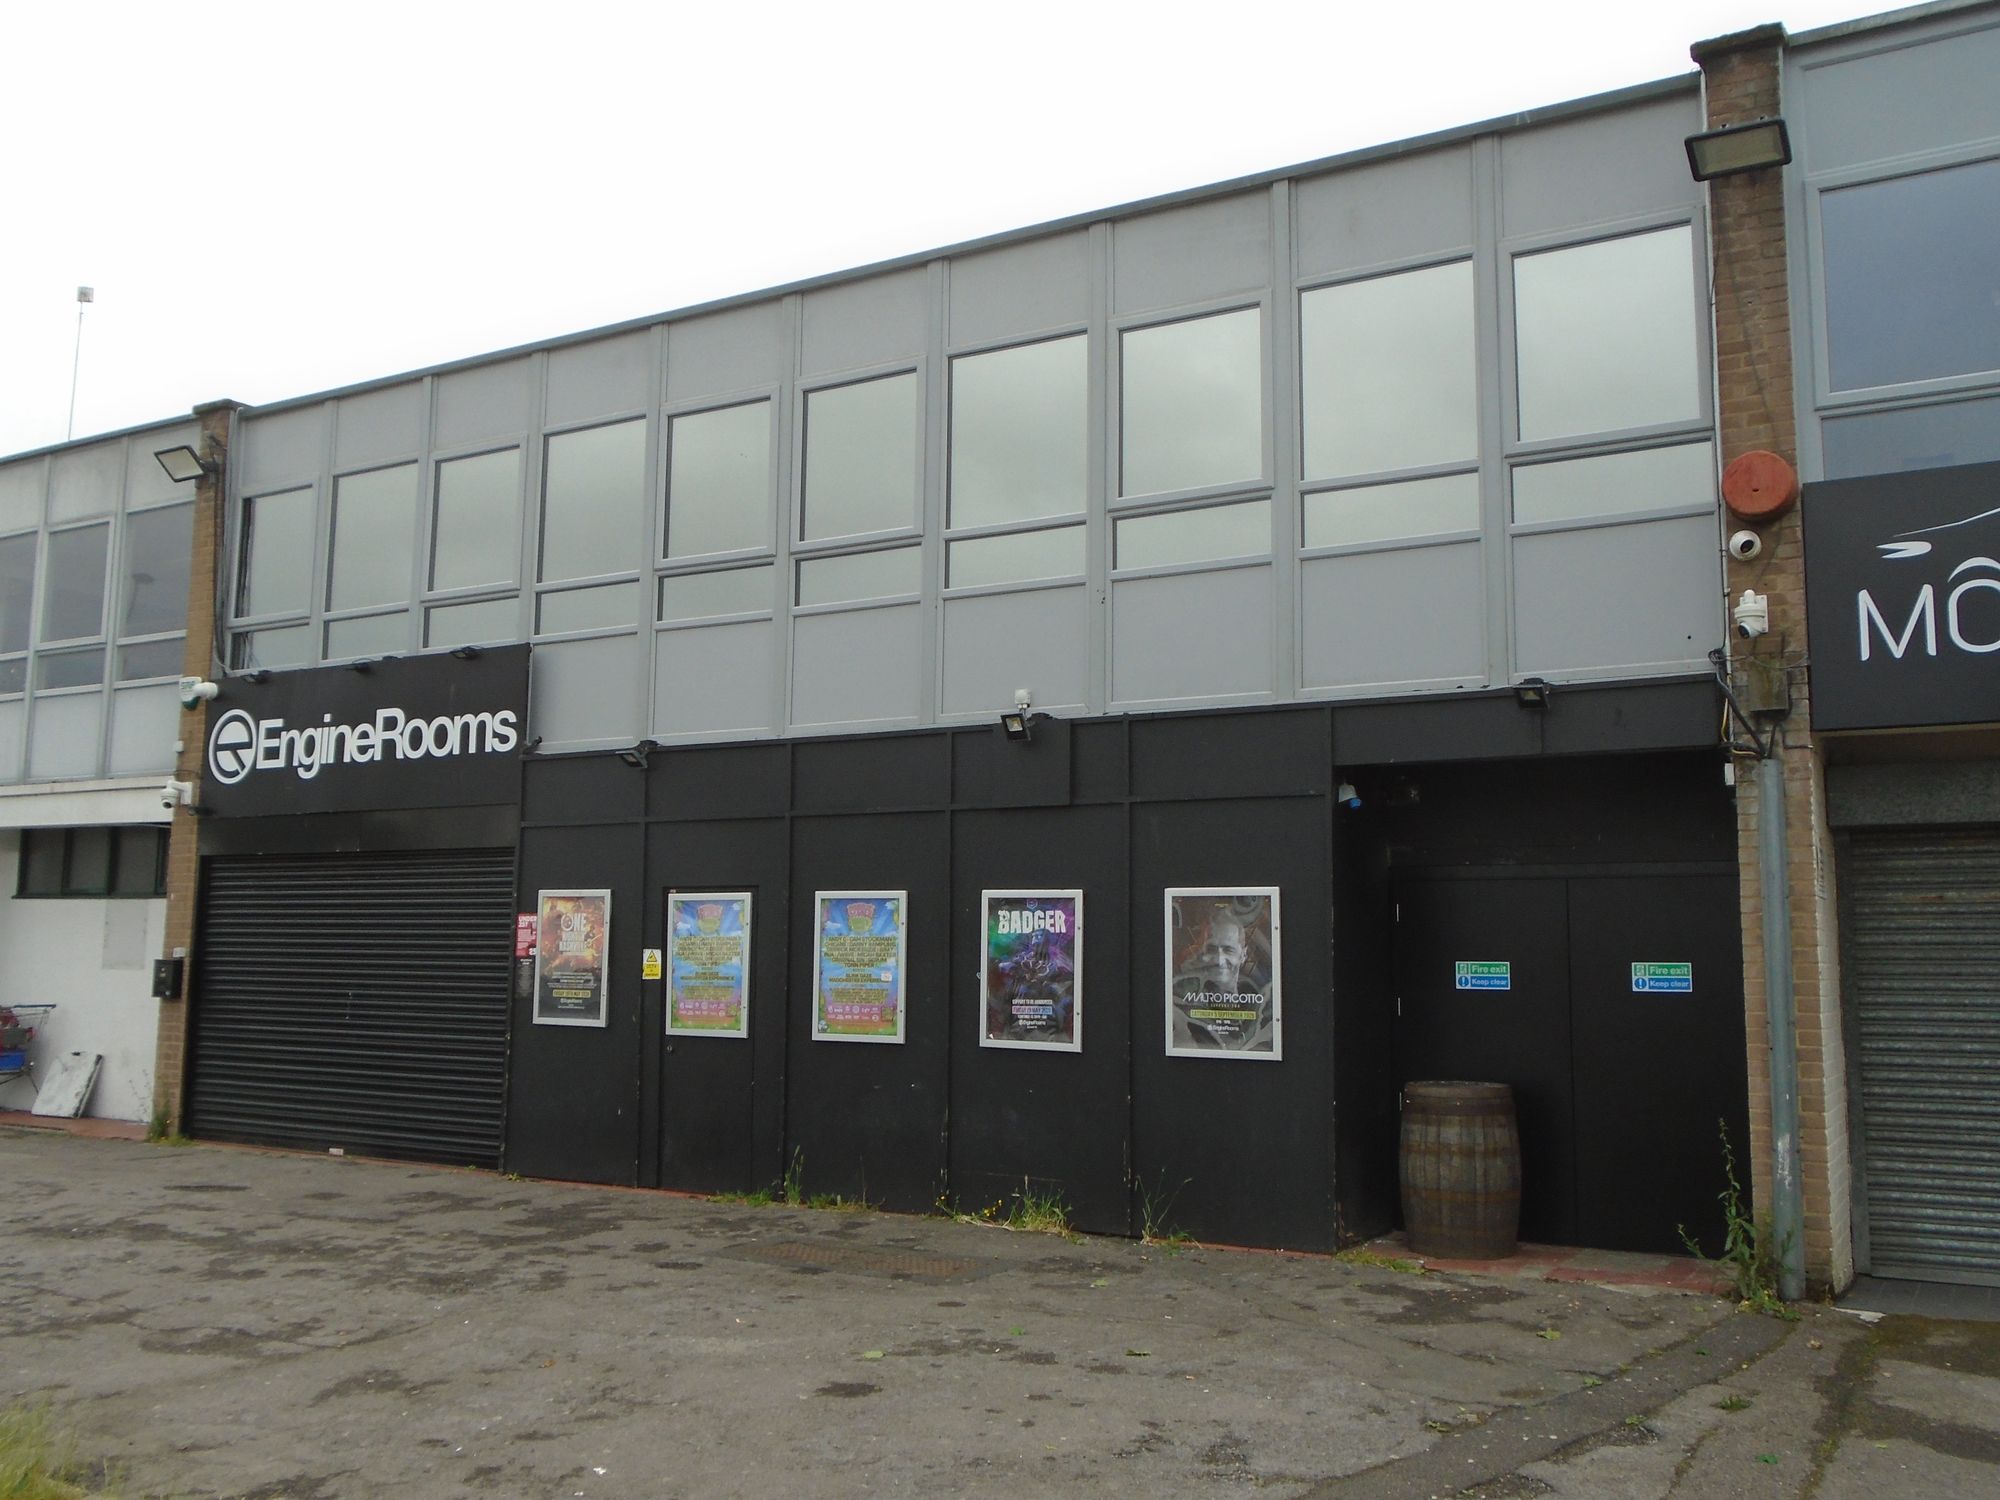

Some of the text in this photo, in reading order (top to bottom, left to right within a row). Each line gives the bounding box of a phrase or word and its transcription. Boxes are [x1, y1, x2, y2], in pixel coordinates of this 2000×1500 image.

[256, 707, 517, 779] EngineRooms
[561, 912, 587, 931] ONE
[998, 910, 1067, 934] BADGER
[1472, 965, 1507, 974] Fire exit
[1650, 966, 1688, 975] Fire exit
[1472, 978, 1489, 986] Keep
[1650, 980, 1670, 988] Keep
[1223, 993, 1264, 1004] PICOTTO
